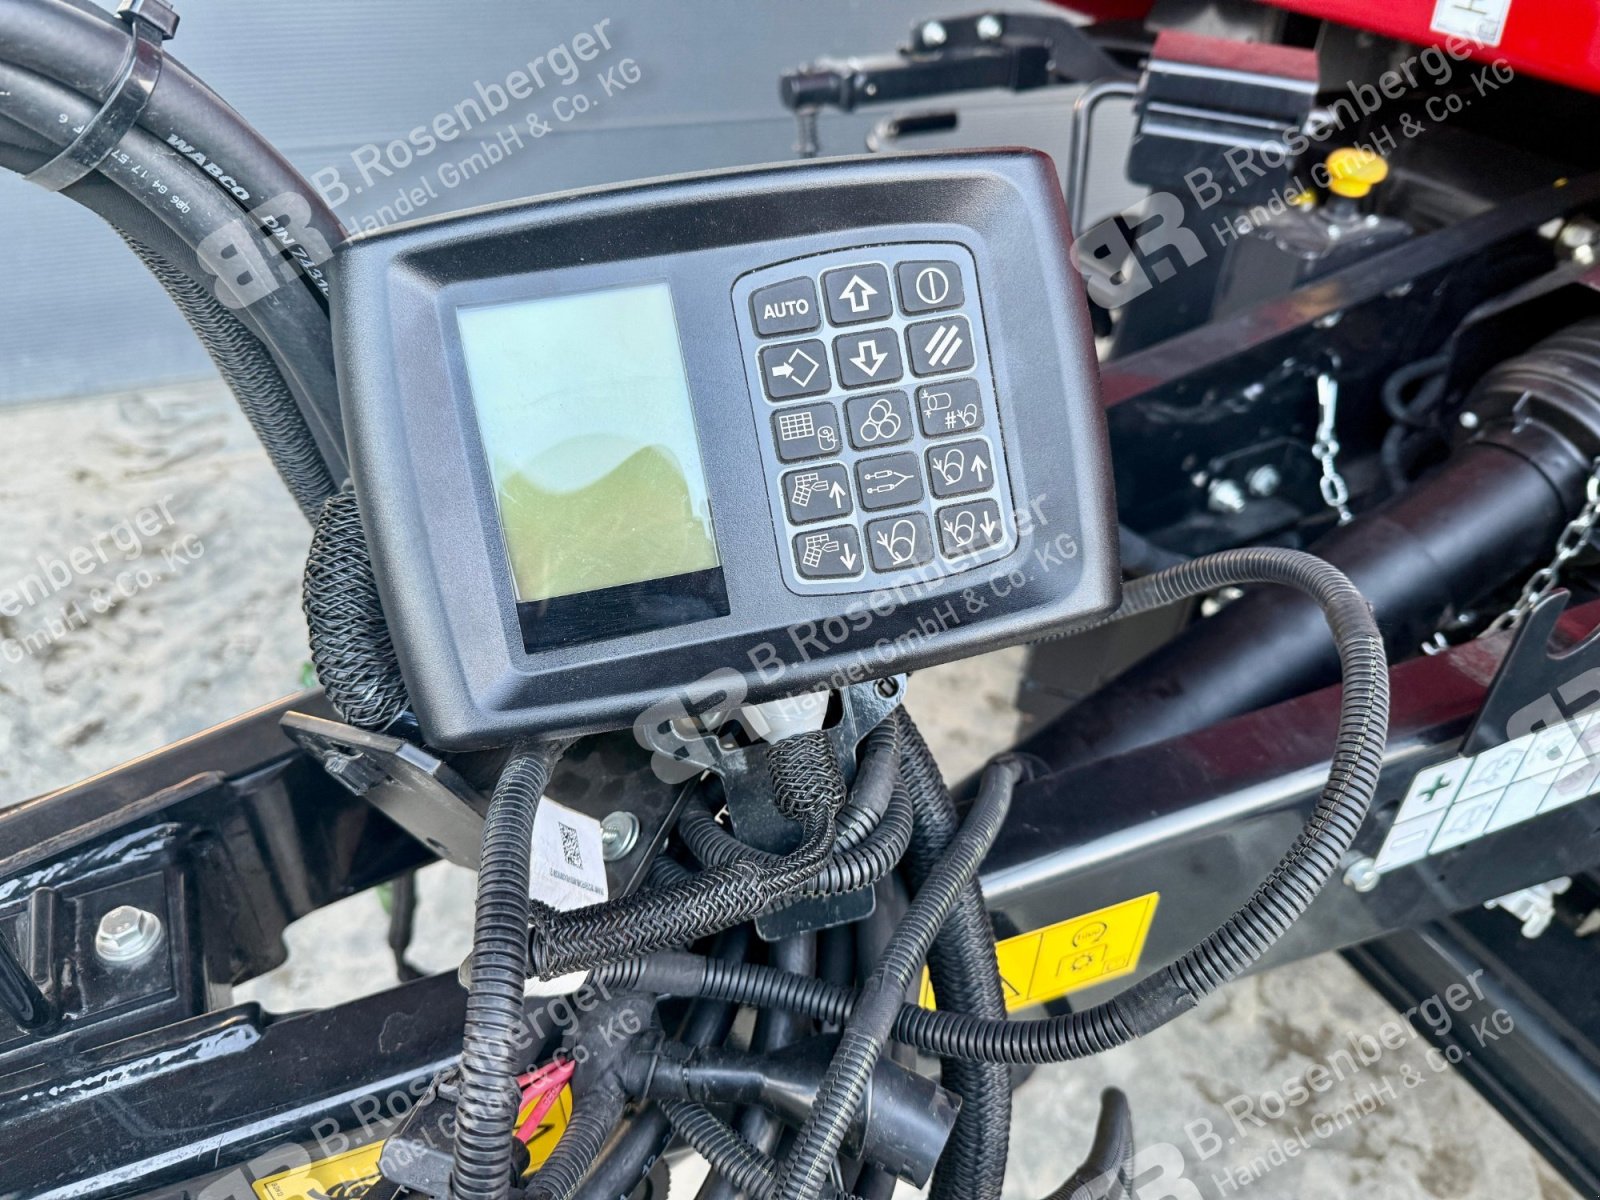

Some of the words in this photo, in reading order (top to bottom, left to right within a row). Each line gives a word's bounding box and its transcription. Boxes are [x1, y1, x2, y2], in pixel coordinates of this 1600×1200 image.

[166, 133, 250, 201] WABCO
[261, 214, 295, 244] DIN
[763, 298, 809, 320] AUTO
